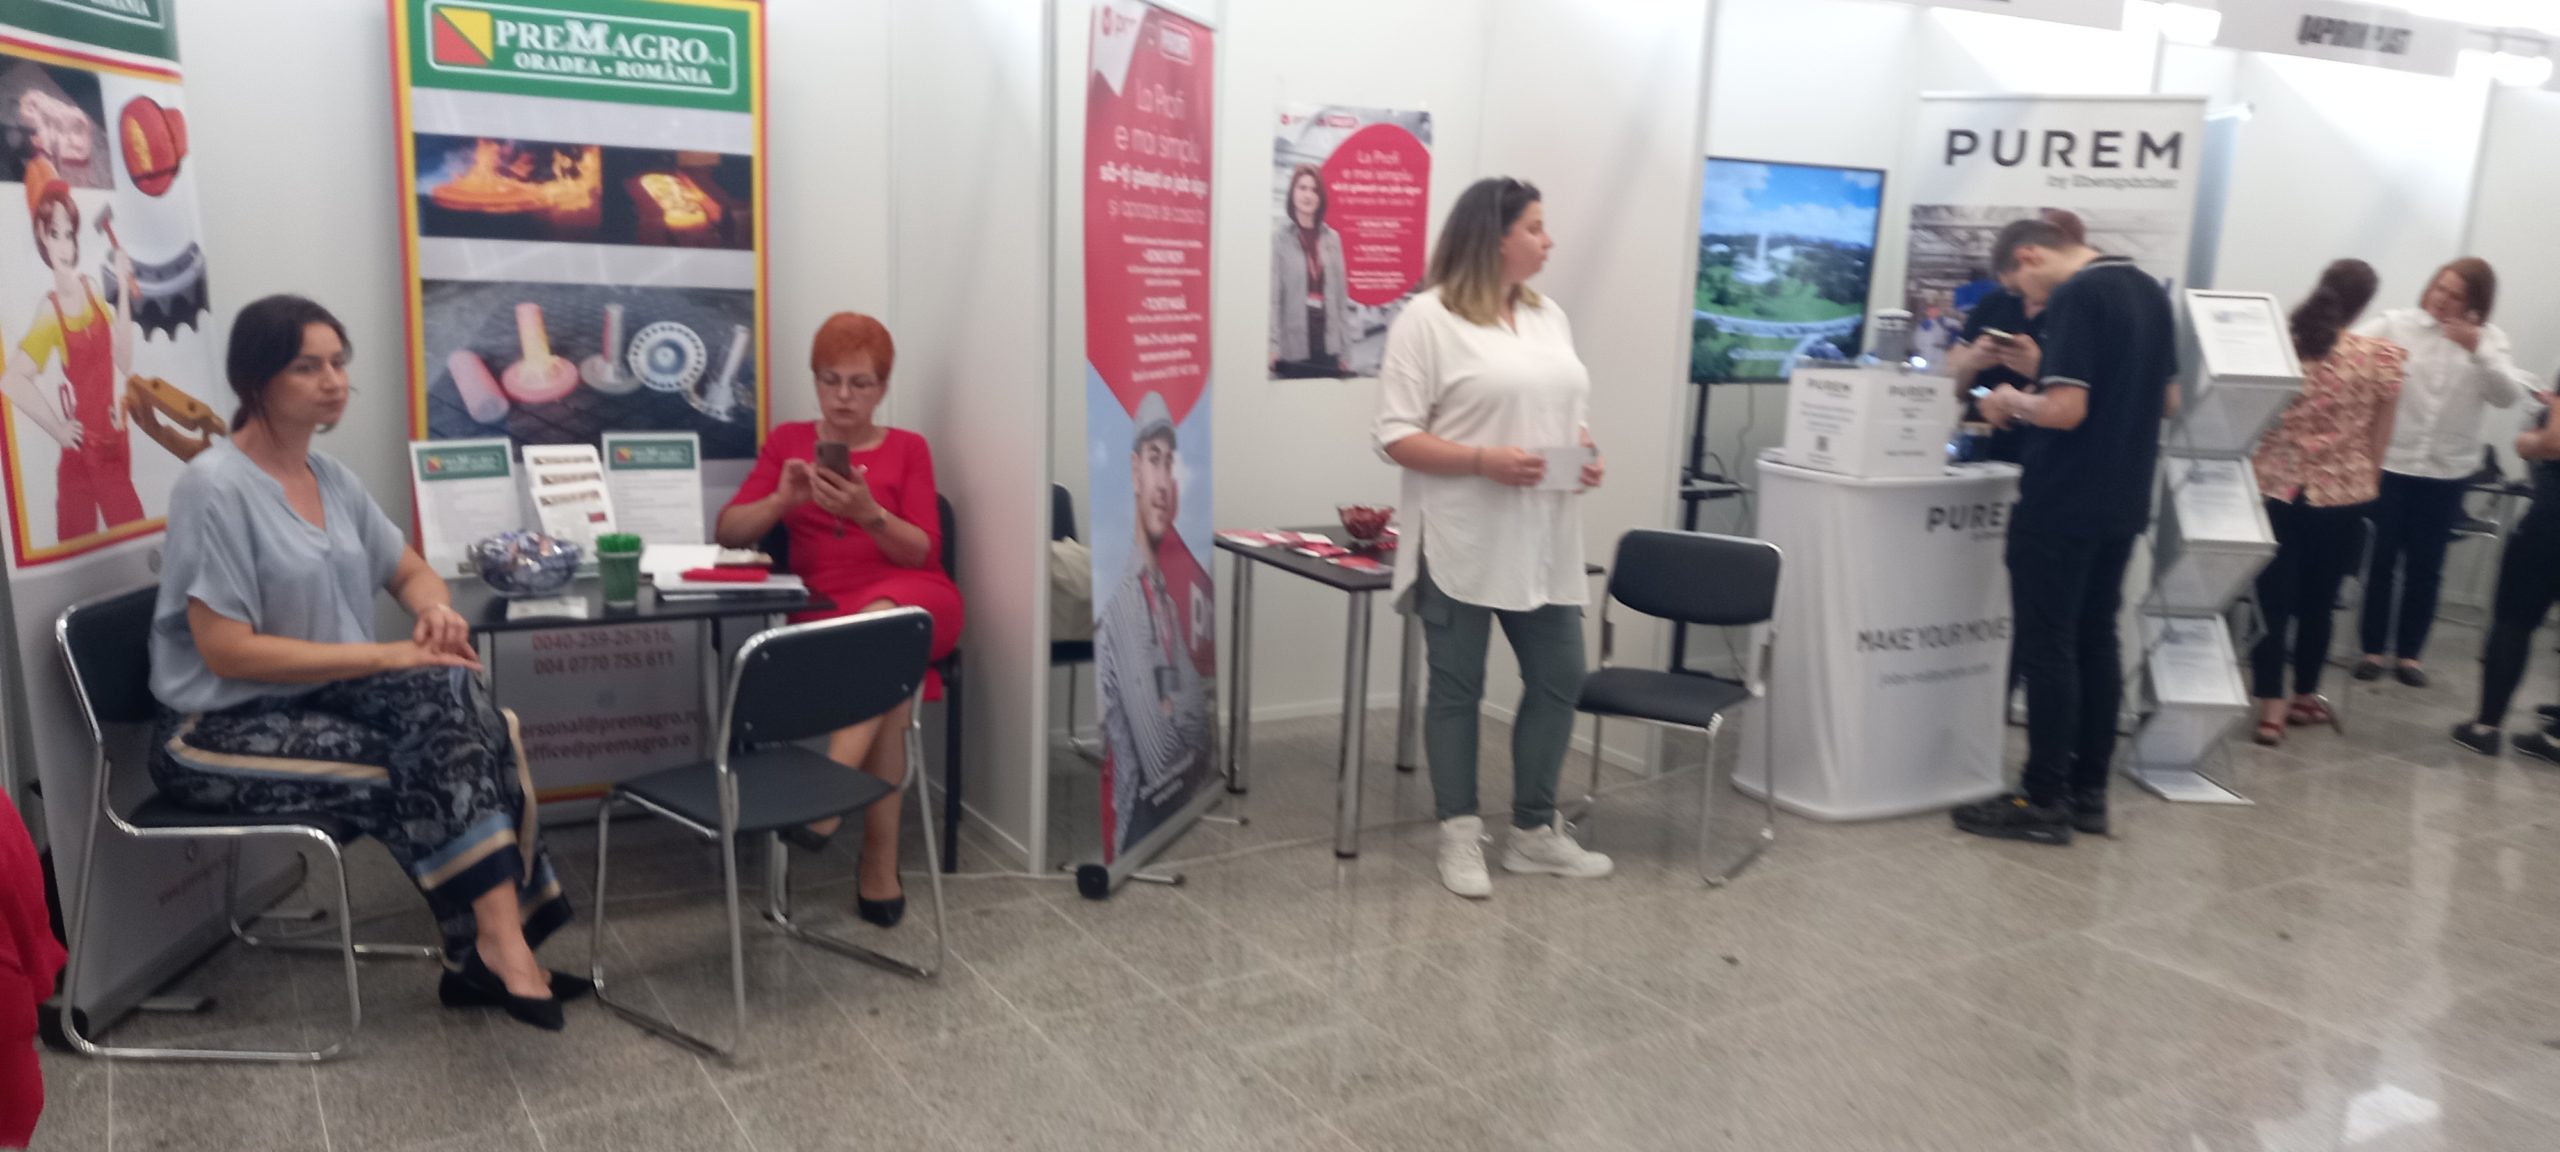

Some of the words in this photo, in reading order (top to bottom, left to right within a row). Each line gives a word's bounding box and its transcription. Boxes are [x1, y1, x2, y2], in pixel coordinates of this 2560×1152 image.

[495, 18, 709, 65] PREMAGRO
[513, 51, 602, 76] ORADEA
[615, 60, 713, 86] ROMÂNIA
[1114, 125, 1129, 151] e
[1944, 129, 2184, 170] PUREM
[1926, 502, 2005, 533] PURE
[1857, 627, 1913, 652] MAKE
[1917, 623, 1964, 649] YOUR
[520, 710, 700, 740] ersonal@premagro.r
